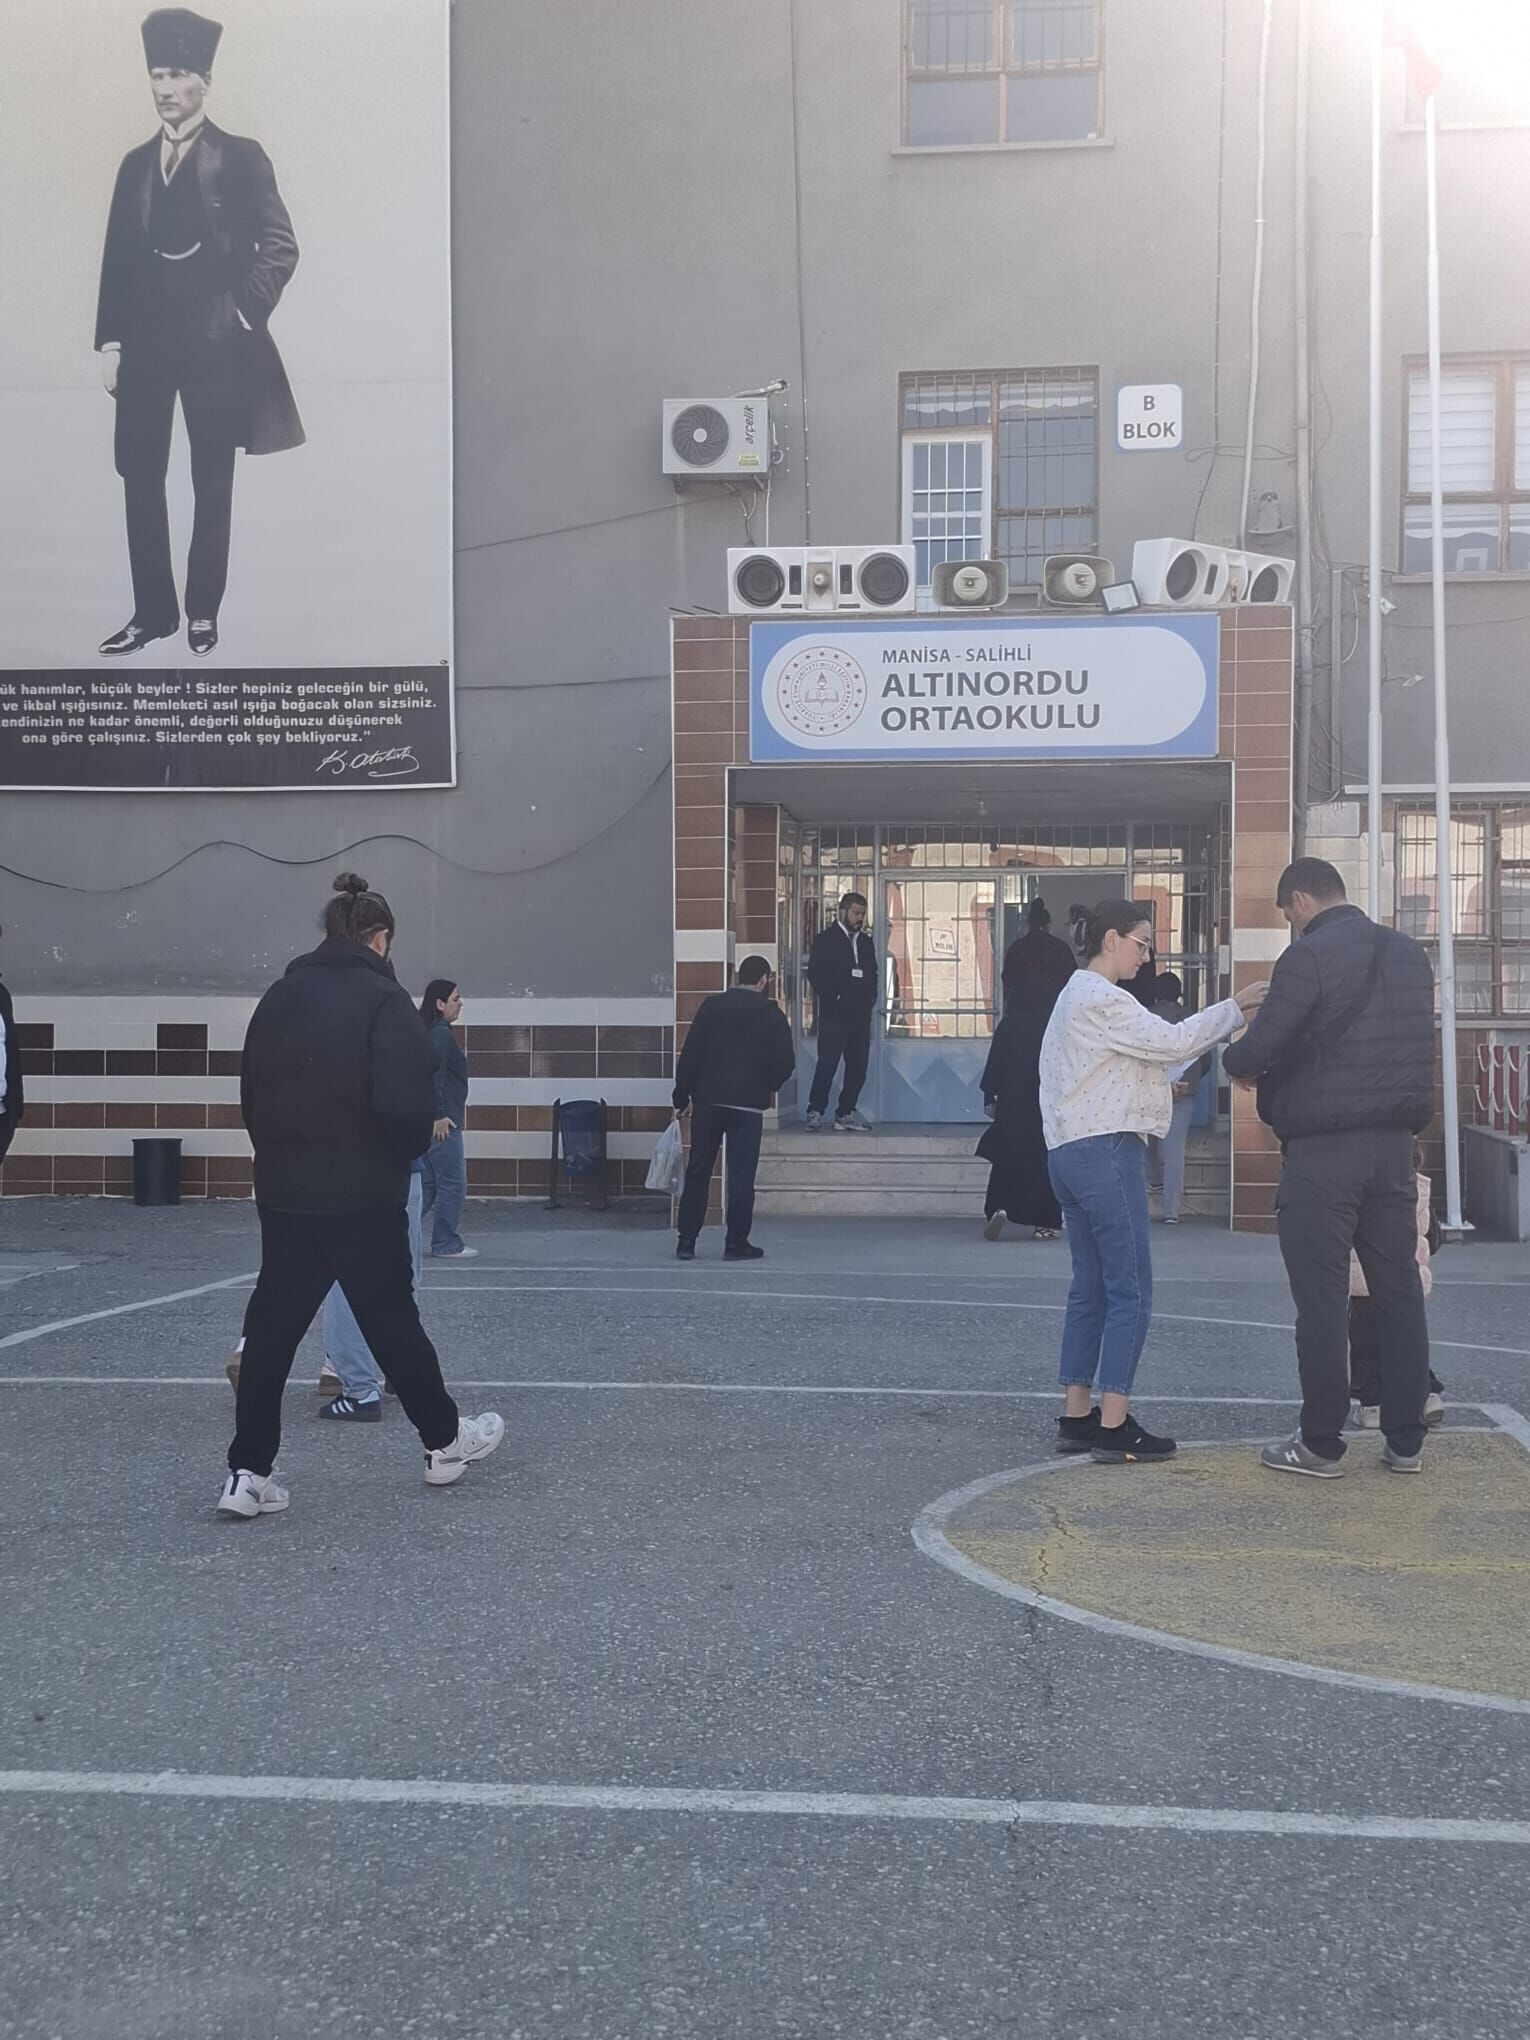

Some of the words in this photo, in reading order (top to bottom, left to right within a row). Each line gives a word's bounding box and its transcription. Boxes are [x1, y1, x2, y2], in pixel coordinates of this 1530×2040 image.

[1143, 395, 1155, 411] B
[1123, 421, 1176, 439] BLOK
[882, 646, 951, 664] MANİSA
[965, 644, 1031, 662] SALİHLİ
[90, 682, 133, 697] küçük
[137, 682, 181, 697] beyler
[195, 682, 238, 694] Sizler
[242, 682, 293, 697] hepiniz
[297, 681, 364, 696] geleceğin
[368, 681, 389, 693] bir
[881, 670, 1089, 698] ALTINORDU
[2, 702, 19, 711] ve
[23, 699, 56, 711] ikbal
[133, 698, 208, 711] Memleketi
[212, 698, 238, 711] asıl
[243, 698, 277, 713] ışığa
[281, 698, 339, 711] boğacak
[344, 697, 373, 709] olan
[0, 715, 63, 728] endinizin
[68, 717, 85, 728] ne
[89, 715, 130, 727] kadar
[189, 714, 239, 728] değerli
[243, 714, 323, 728] olduğunuzu
[328, 713, 403, 728] düşünerek
[880, 703, 1101, 731] ORTAOKULU
[22, 733, 47, 744] ona
[52, 731, 84, 746] göre
[155, 731, 223, 743] Sizlerden
[227, 730, 251, 745] çok
[256, 732, 281, 745] şey
